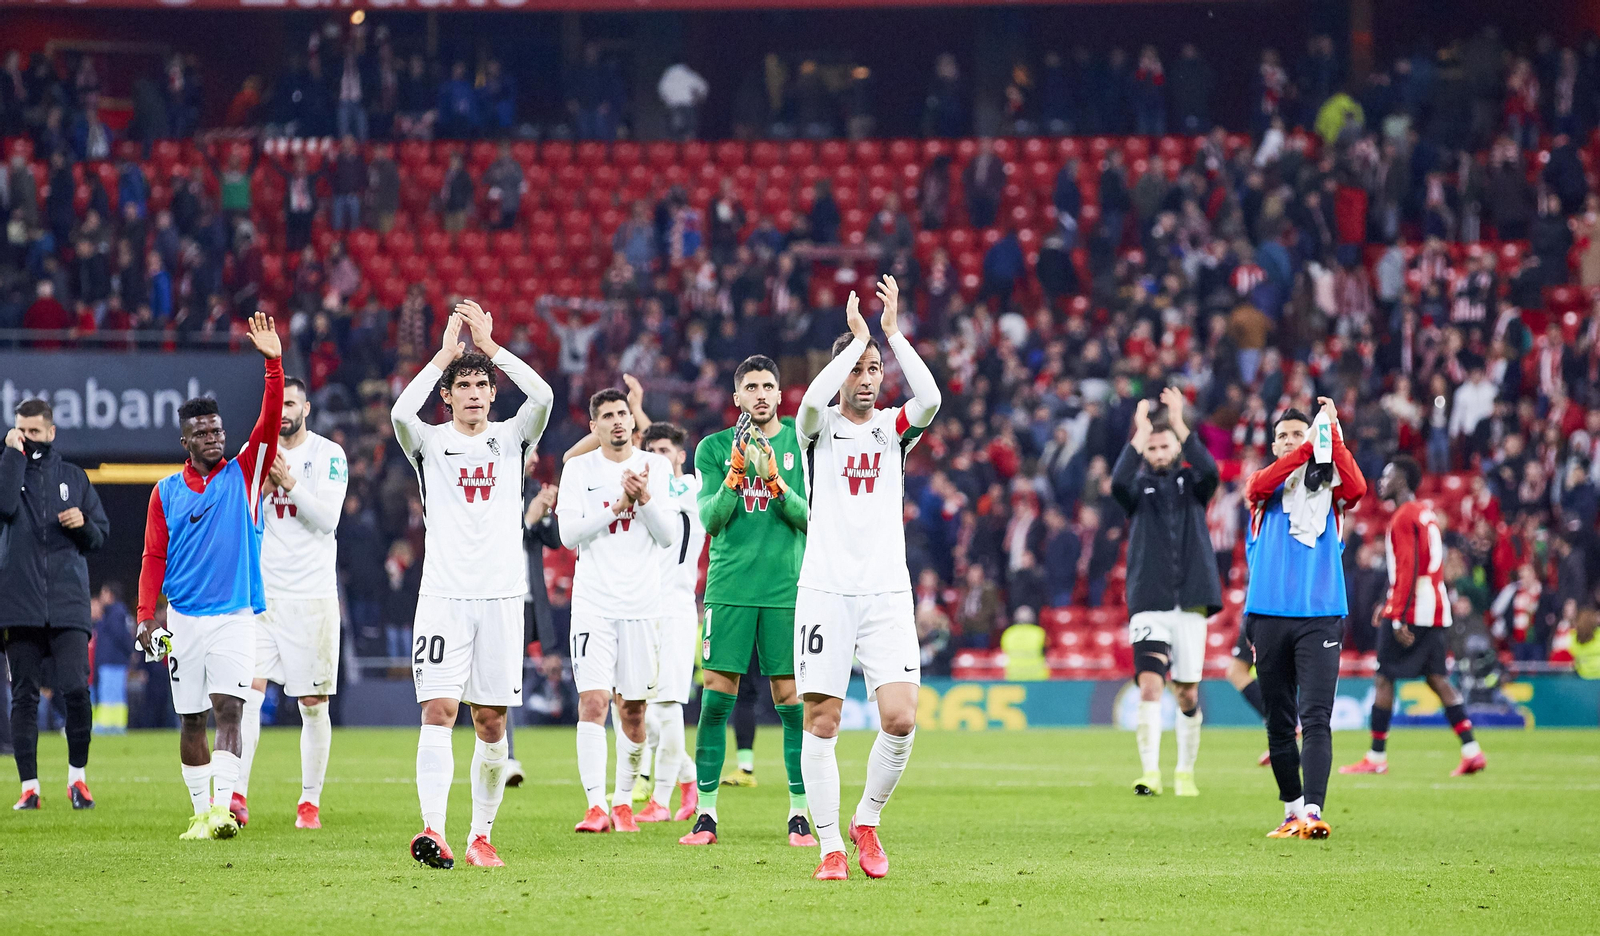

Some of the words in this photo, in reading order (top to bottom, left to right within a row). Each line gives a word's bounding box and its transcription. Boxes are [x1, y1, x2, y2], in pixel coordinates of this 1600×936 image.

[462, 477, 493, 487] WINAMAX
[846, 467, 878, 478] WINAMAX
[743, 488, 771, 498] WINAMAX
[573, 632, 590, 659] 17
[800, 624, 824, 655] 16
[414, 635, 446, 664] 20
